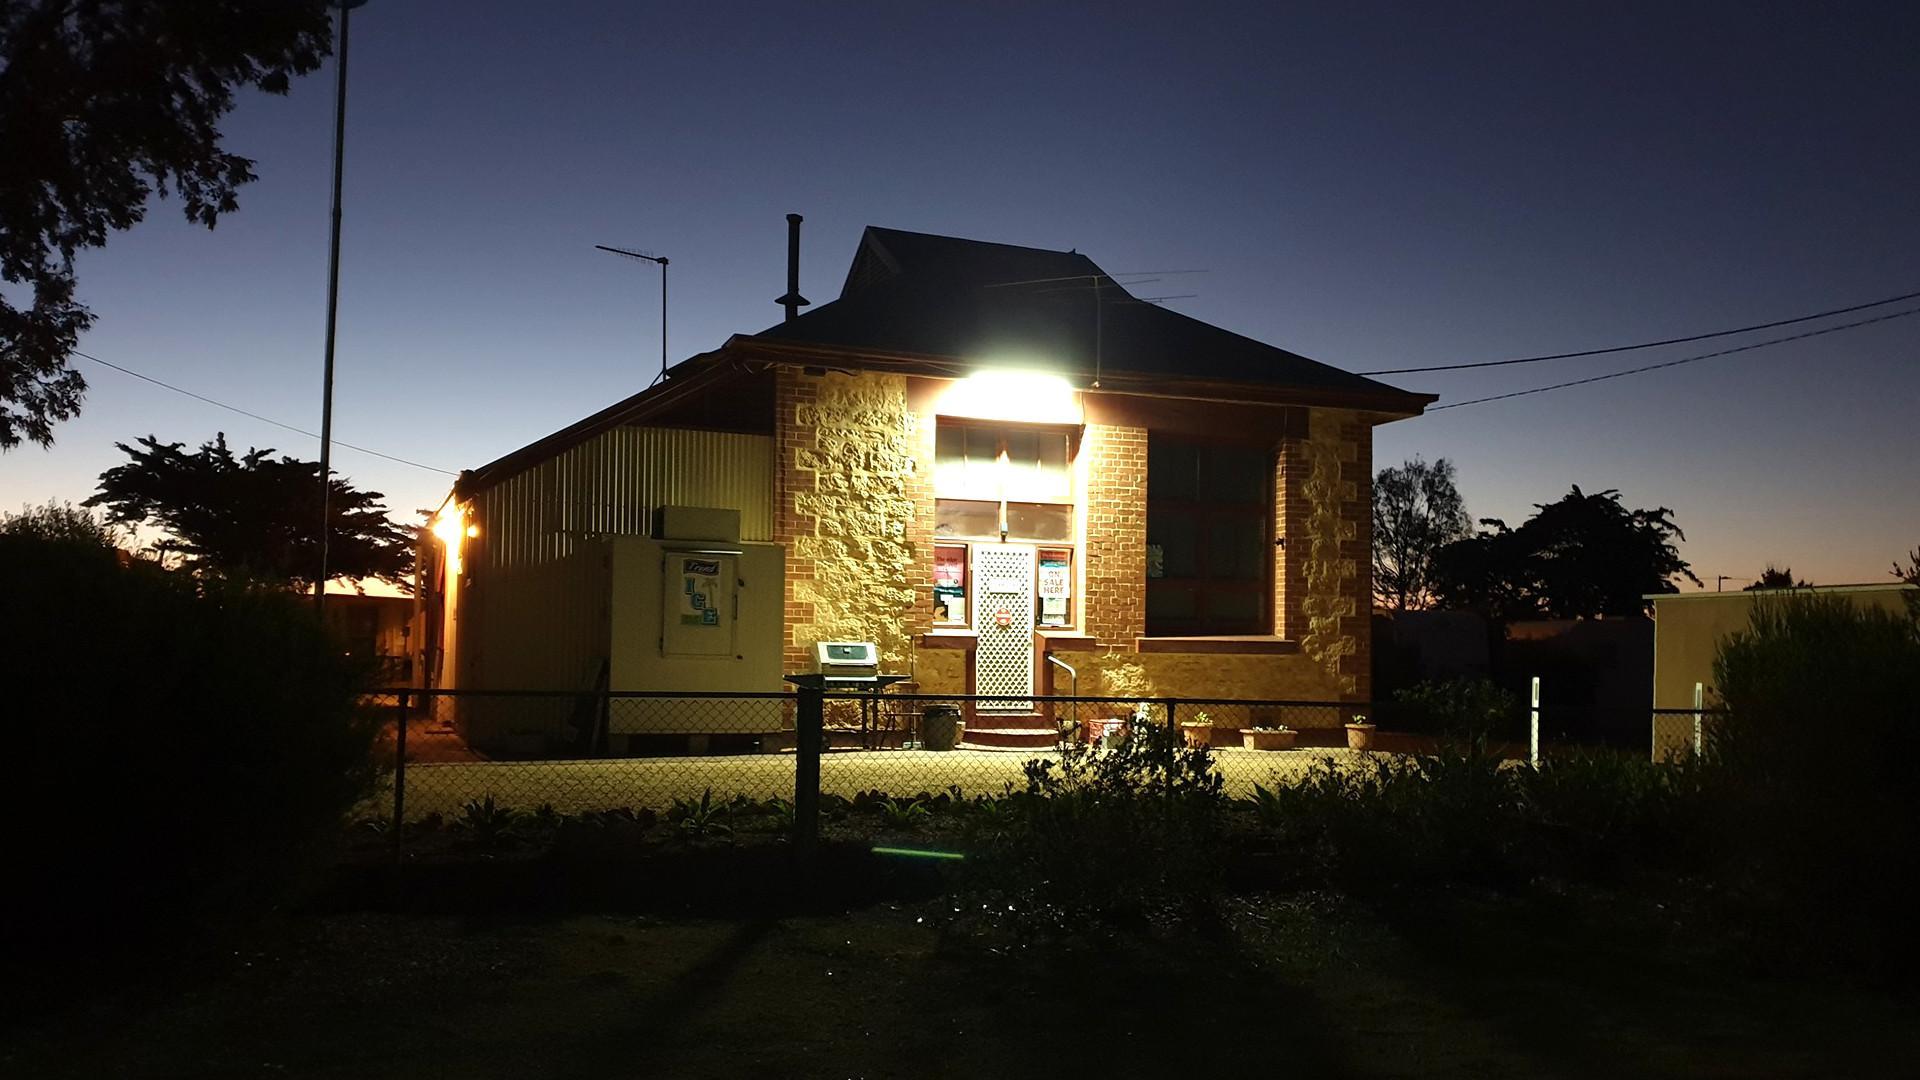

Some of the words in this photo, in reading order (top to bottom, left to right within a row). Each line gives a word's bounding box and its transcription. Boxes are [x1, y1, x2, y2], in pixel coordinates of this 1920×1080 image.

[1048, 570, 1060, 578] ON
[1044, 578, 1064, 587] SALE
[1043, 586, 1064, 594] HERE
[685, 577, 717, 625] ICE
